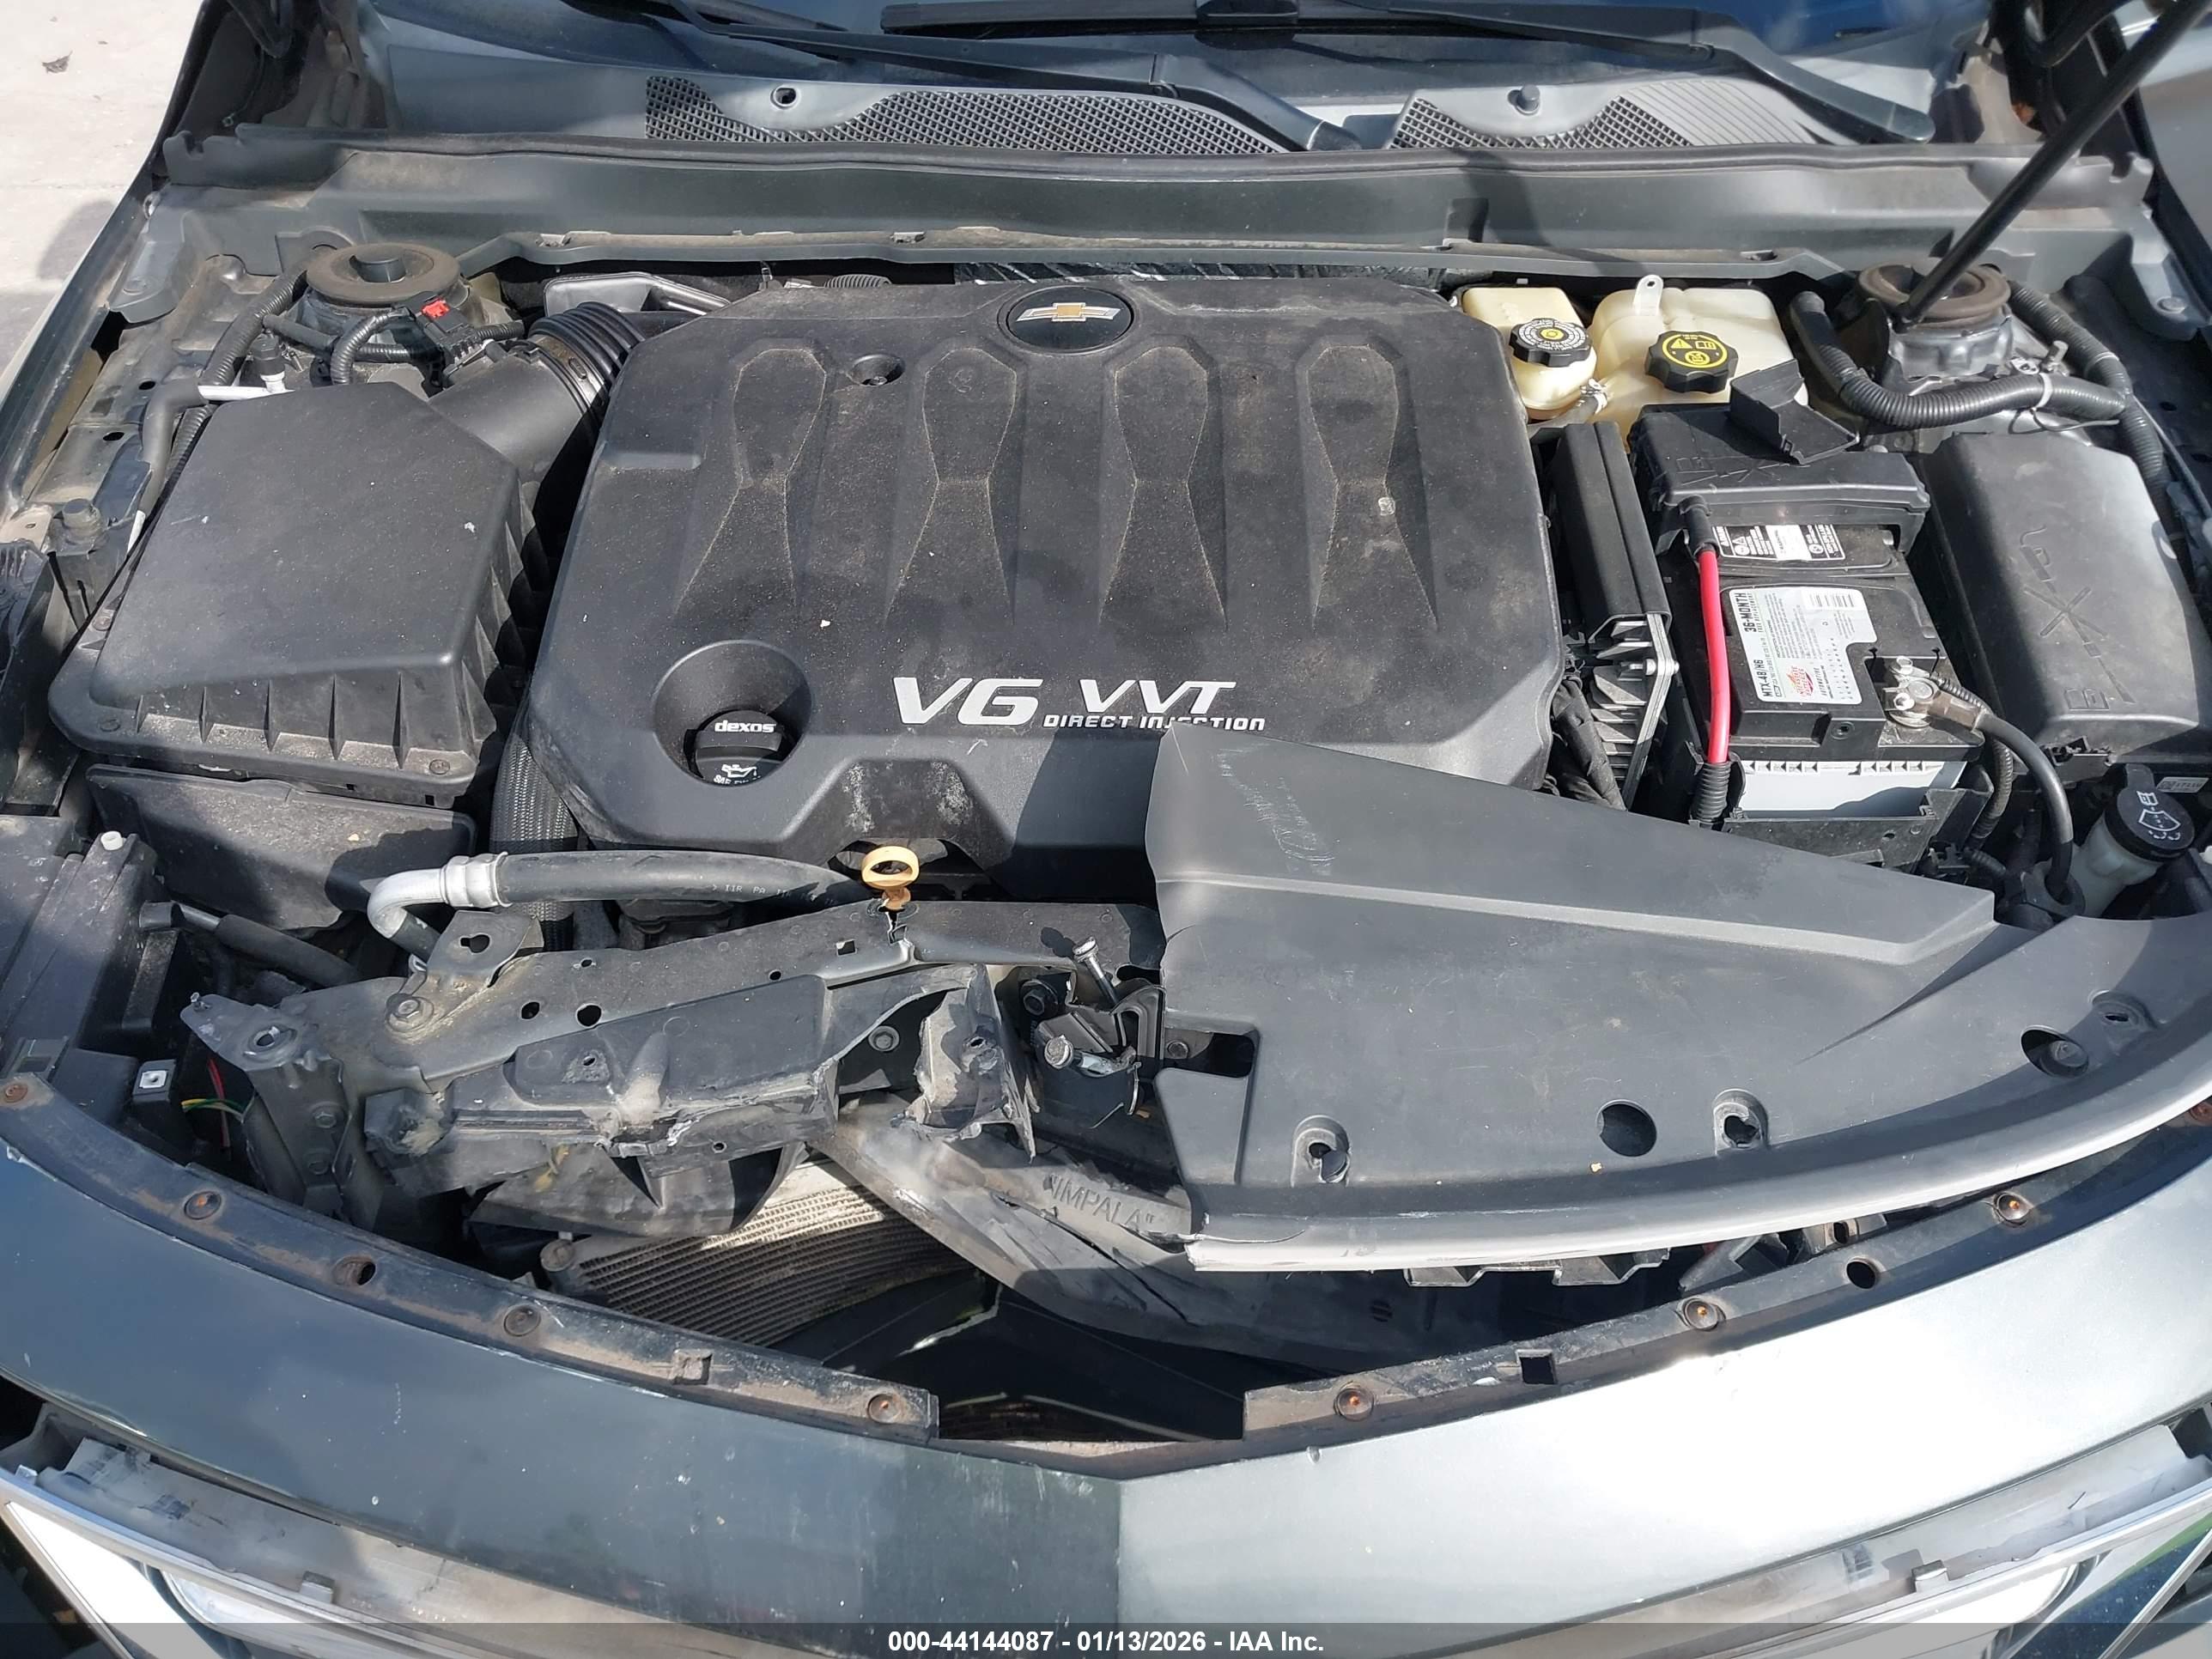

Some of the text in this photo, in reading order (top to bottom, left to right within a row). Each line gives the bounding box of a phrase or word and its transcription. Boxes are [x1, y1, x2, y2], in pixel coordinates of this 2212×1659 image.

[1734, 592, 1757, 632] 36-MONTH
[893, 677, 1237, 726] V6 VVT
[714, 720, 777, 733] dexos
[1042, 714, 1133, 728] DIRECT
